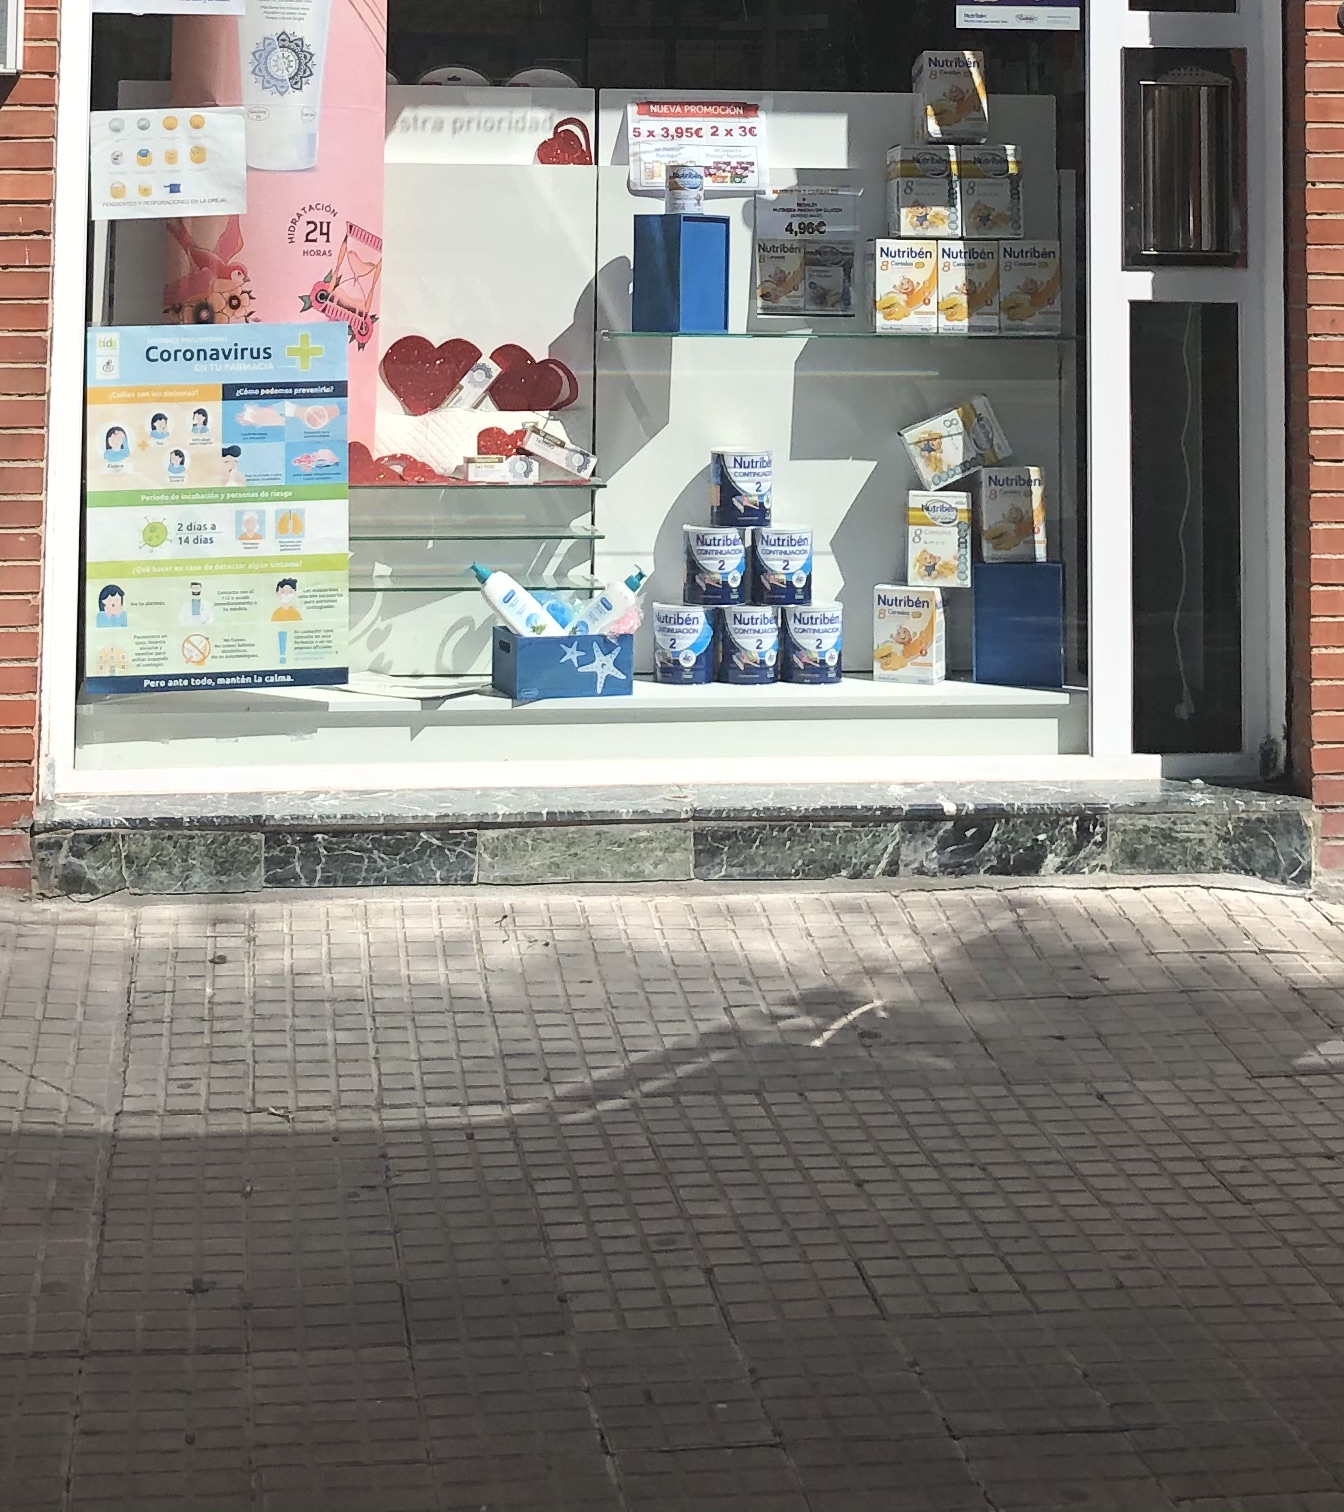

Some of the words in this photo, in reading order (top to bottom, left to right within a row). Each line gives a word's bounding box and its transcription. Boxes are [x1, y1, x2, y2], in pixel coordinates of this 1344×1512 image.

[928, 56, 980, 69] Nutribén
[650, 104, 683, 115] NUEVA
[684, 104, 744, 115] PROMOCIÓN
[632, 126, 642, 137] 5
[646, 128, 656, 138] x
[660, 126, 704, 141] 3,95€
[710, 125, 719, 136] 2
[724, 127, 734, 137] x
[287, 203, 338, 244] HIDRATACIÓN
[304, 220, 331, 243] 24
[302, 249, 333, 257] HORAS
[880, 246, 932, 259] Nutribén
[942, 247, 994, 260] Nutribén
[1003, 247, 1056, 260] Nutribén
[880, 261, 889, 271] 8
[942, 261, 951, 272] 8
[145, 342, 272, 363] Coronavirus
[755, 481, 762, 493] 2
[988, 474, 1041, 487] Nutribén
[921, 502, 958, 516] Nutribén
[177, 522, 184, 532] 2
[185, 521, 209, 532] días
[210, 523, 217, 531] a
[178, 535, 190, 545] 14
[192, 534, 215, 545] días
[761, 534, 809, 547] Nutribén
[912, 529, 923, 544] 8
[718, 560, 726, 571] 2
[782, 560, 790, 571] 2
[877, 594, 930, 609] Nutribén
[793, 612, 840, 626] Nutribén
[878, 609, 887, 619] 8
[669, 638, 677, 649] 2
[756, 639, 763, 650] 2
[815, 638, 823, 649] 2
[143, 677, 166, 688] Pero
[167, 677, 190, 687] ante
[217, 674, 252, 686] mantén
[253, 674, 263, 684] la
